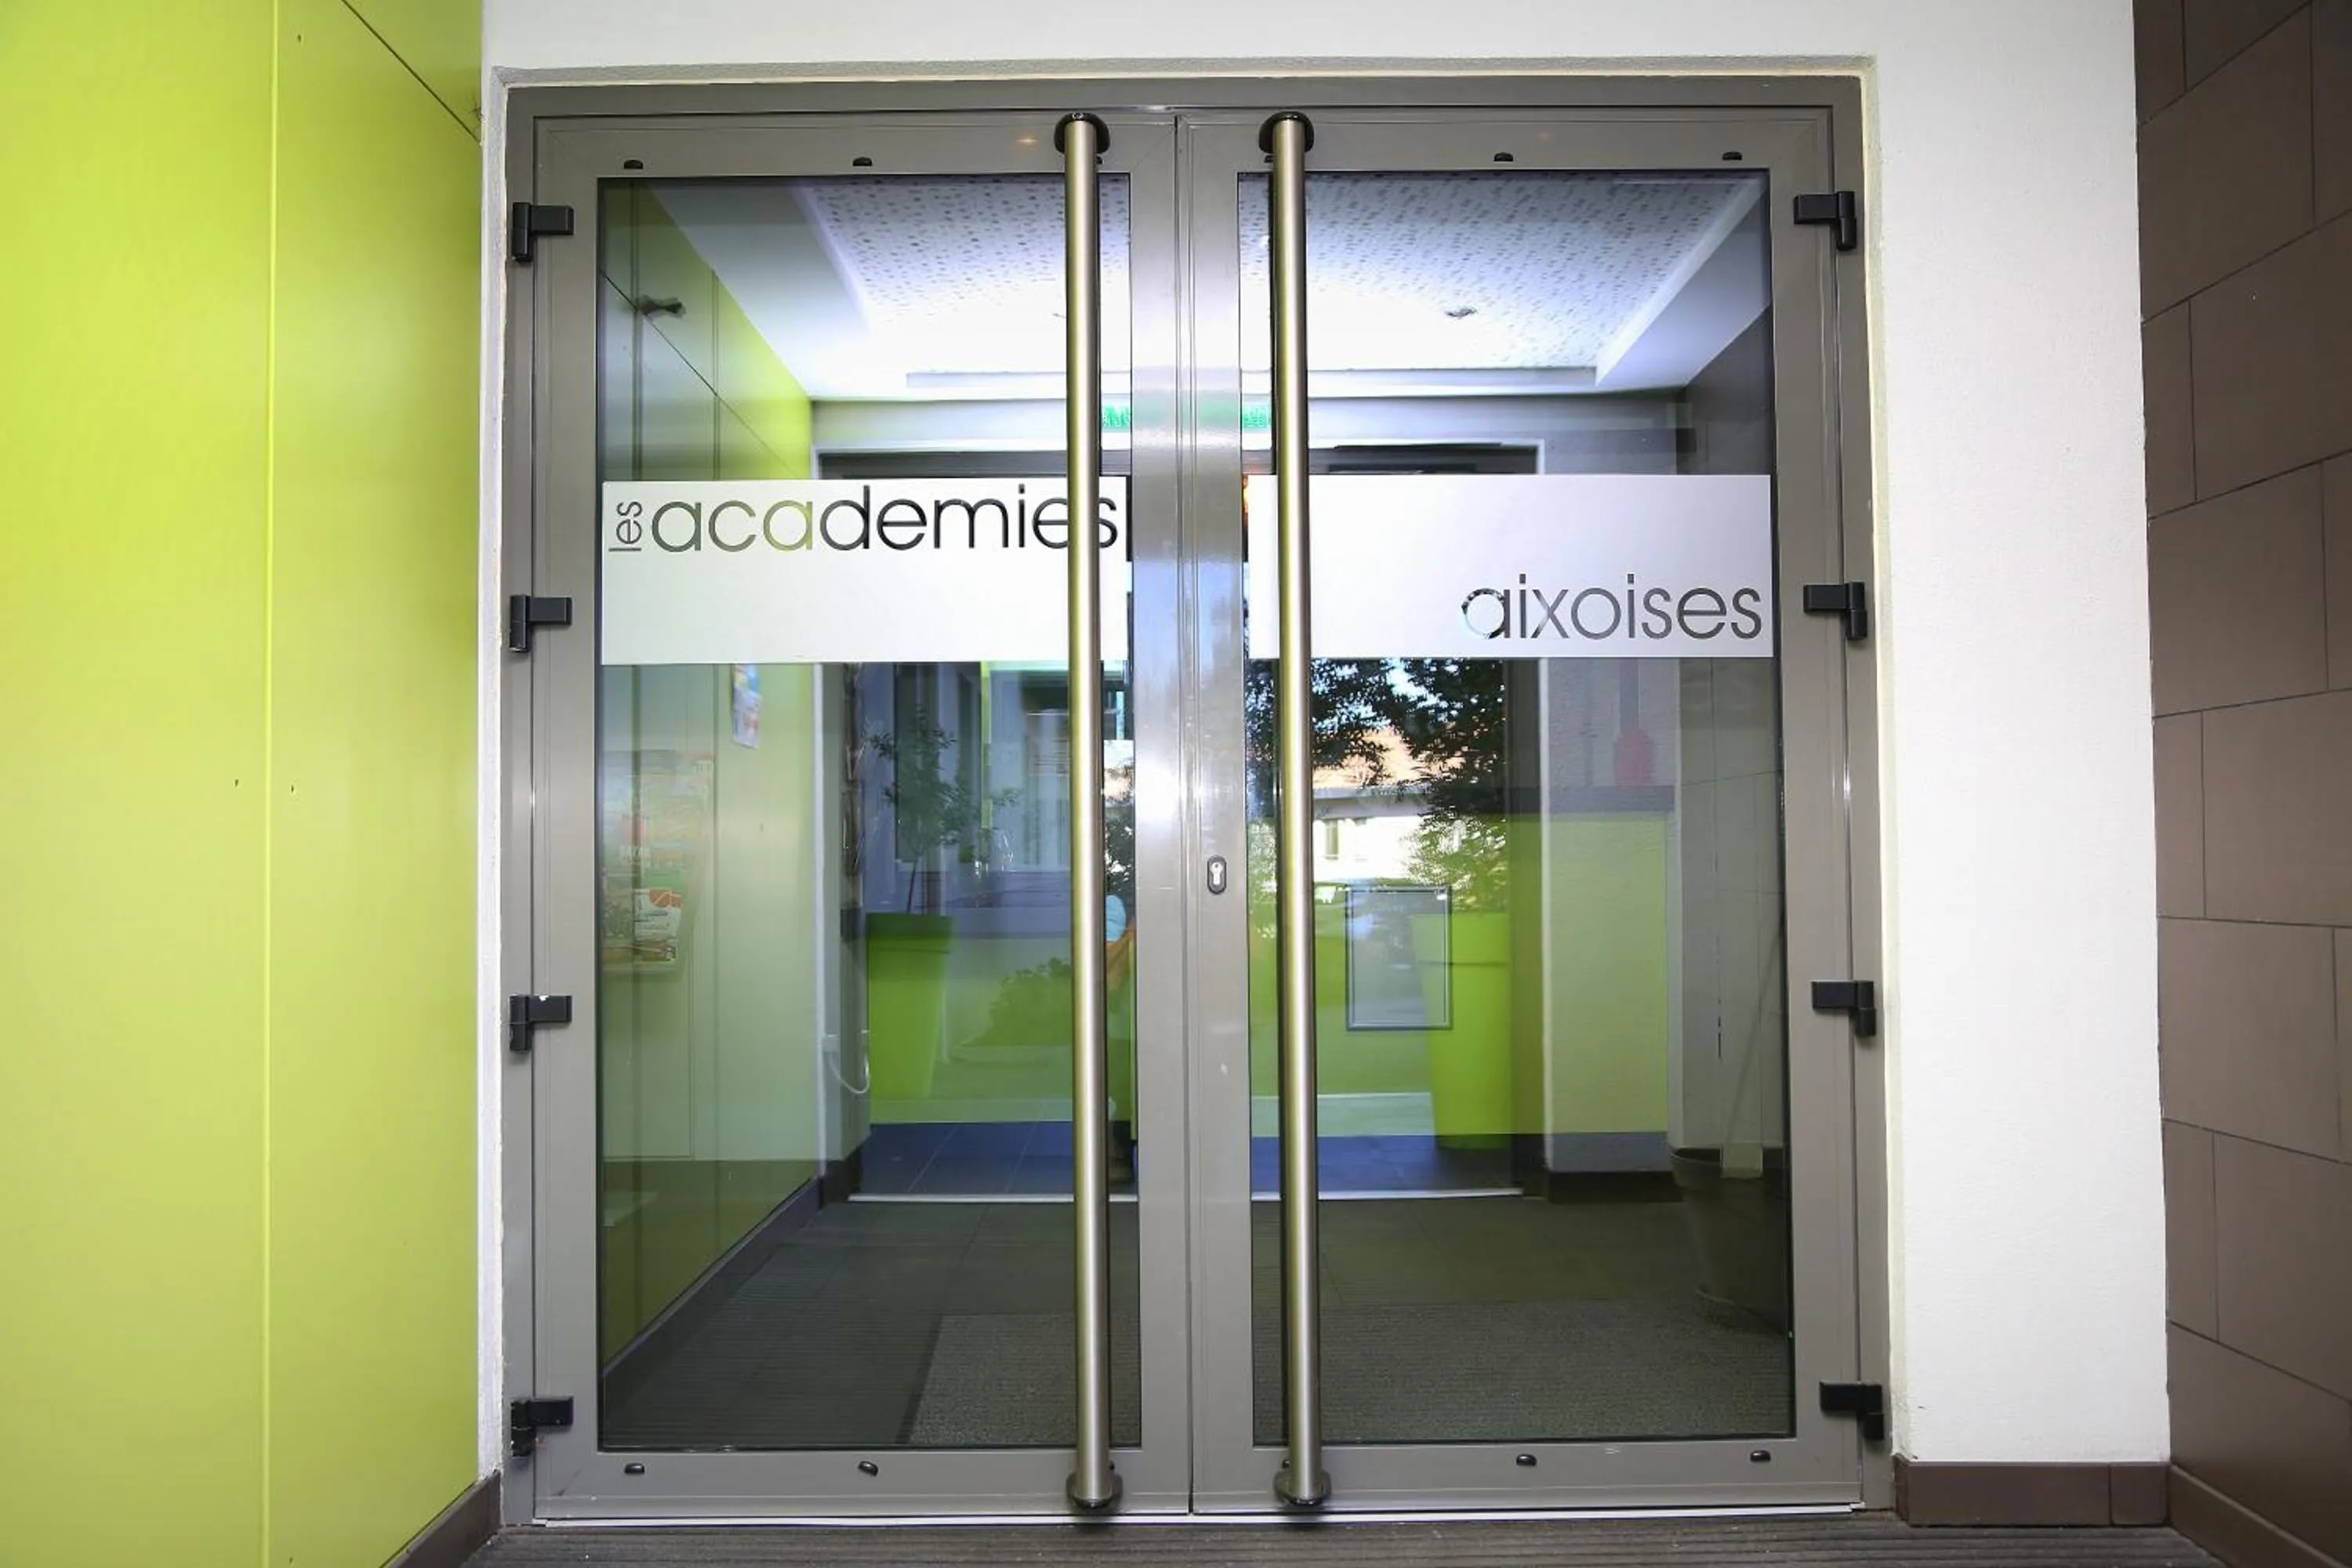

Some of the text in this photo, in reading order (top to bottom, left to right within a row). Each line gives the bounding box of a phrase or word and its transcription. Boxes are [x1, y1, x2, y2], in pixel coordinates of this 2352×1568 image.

[608, 483, 1119, 552] les academies
[1461, 573, 1762, 639] aixoises
